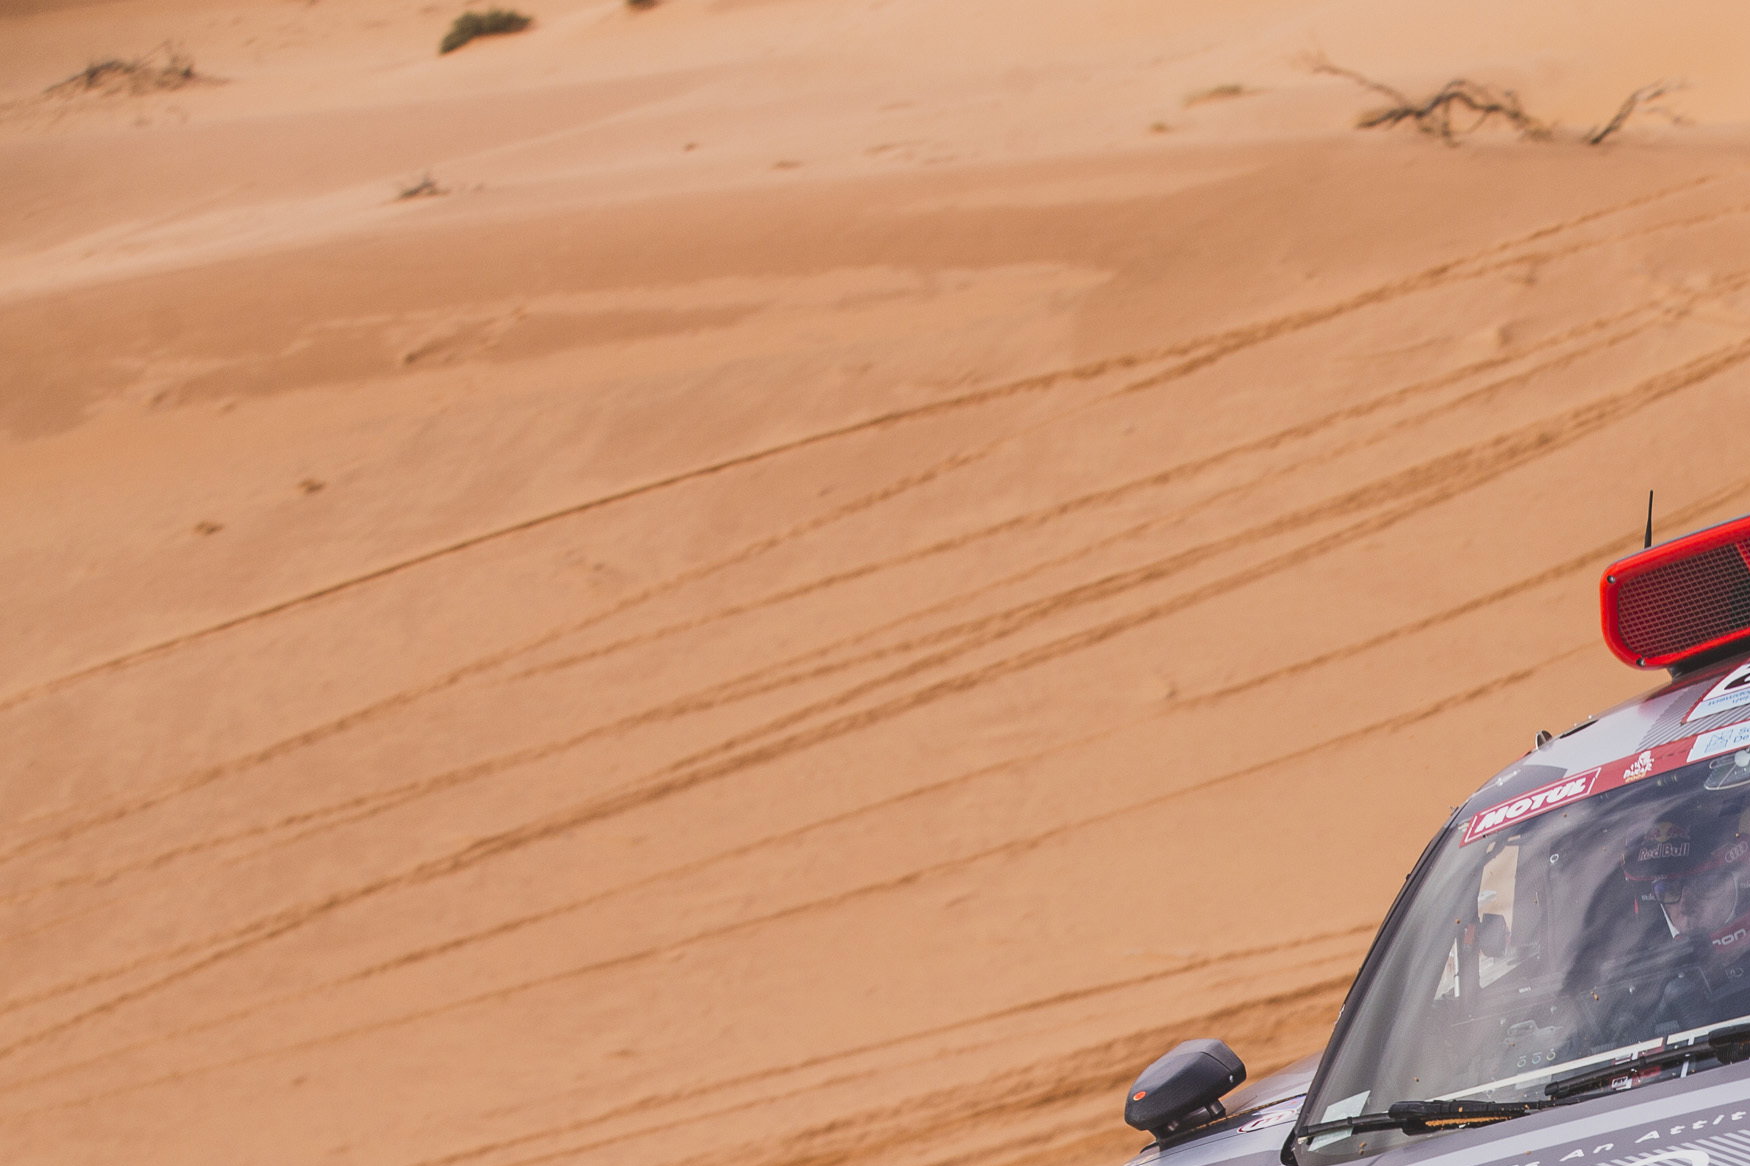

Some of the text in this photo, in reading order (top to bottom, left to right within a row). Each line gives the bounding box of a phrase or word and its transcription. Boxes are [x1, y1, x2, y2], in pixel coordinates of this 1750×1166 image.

[1475, 777, 1587, 834] MOTUL
[1638, 842, 1691, 862] Red Bull
[1559, 1142, 1615, 1162] An
